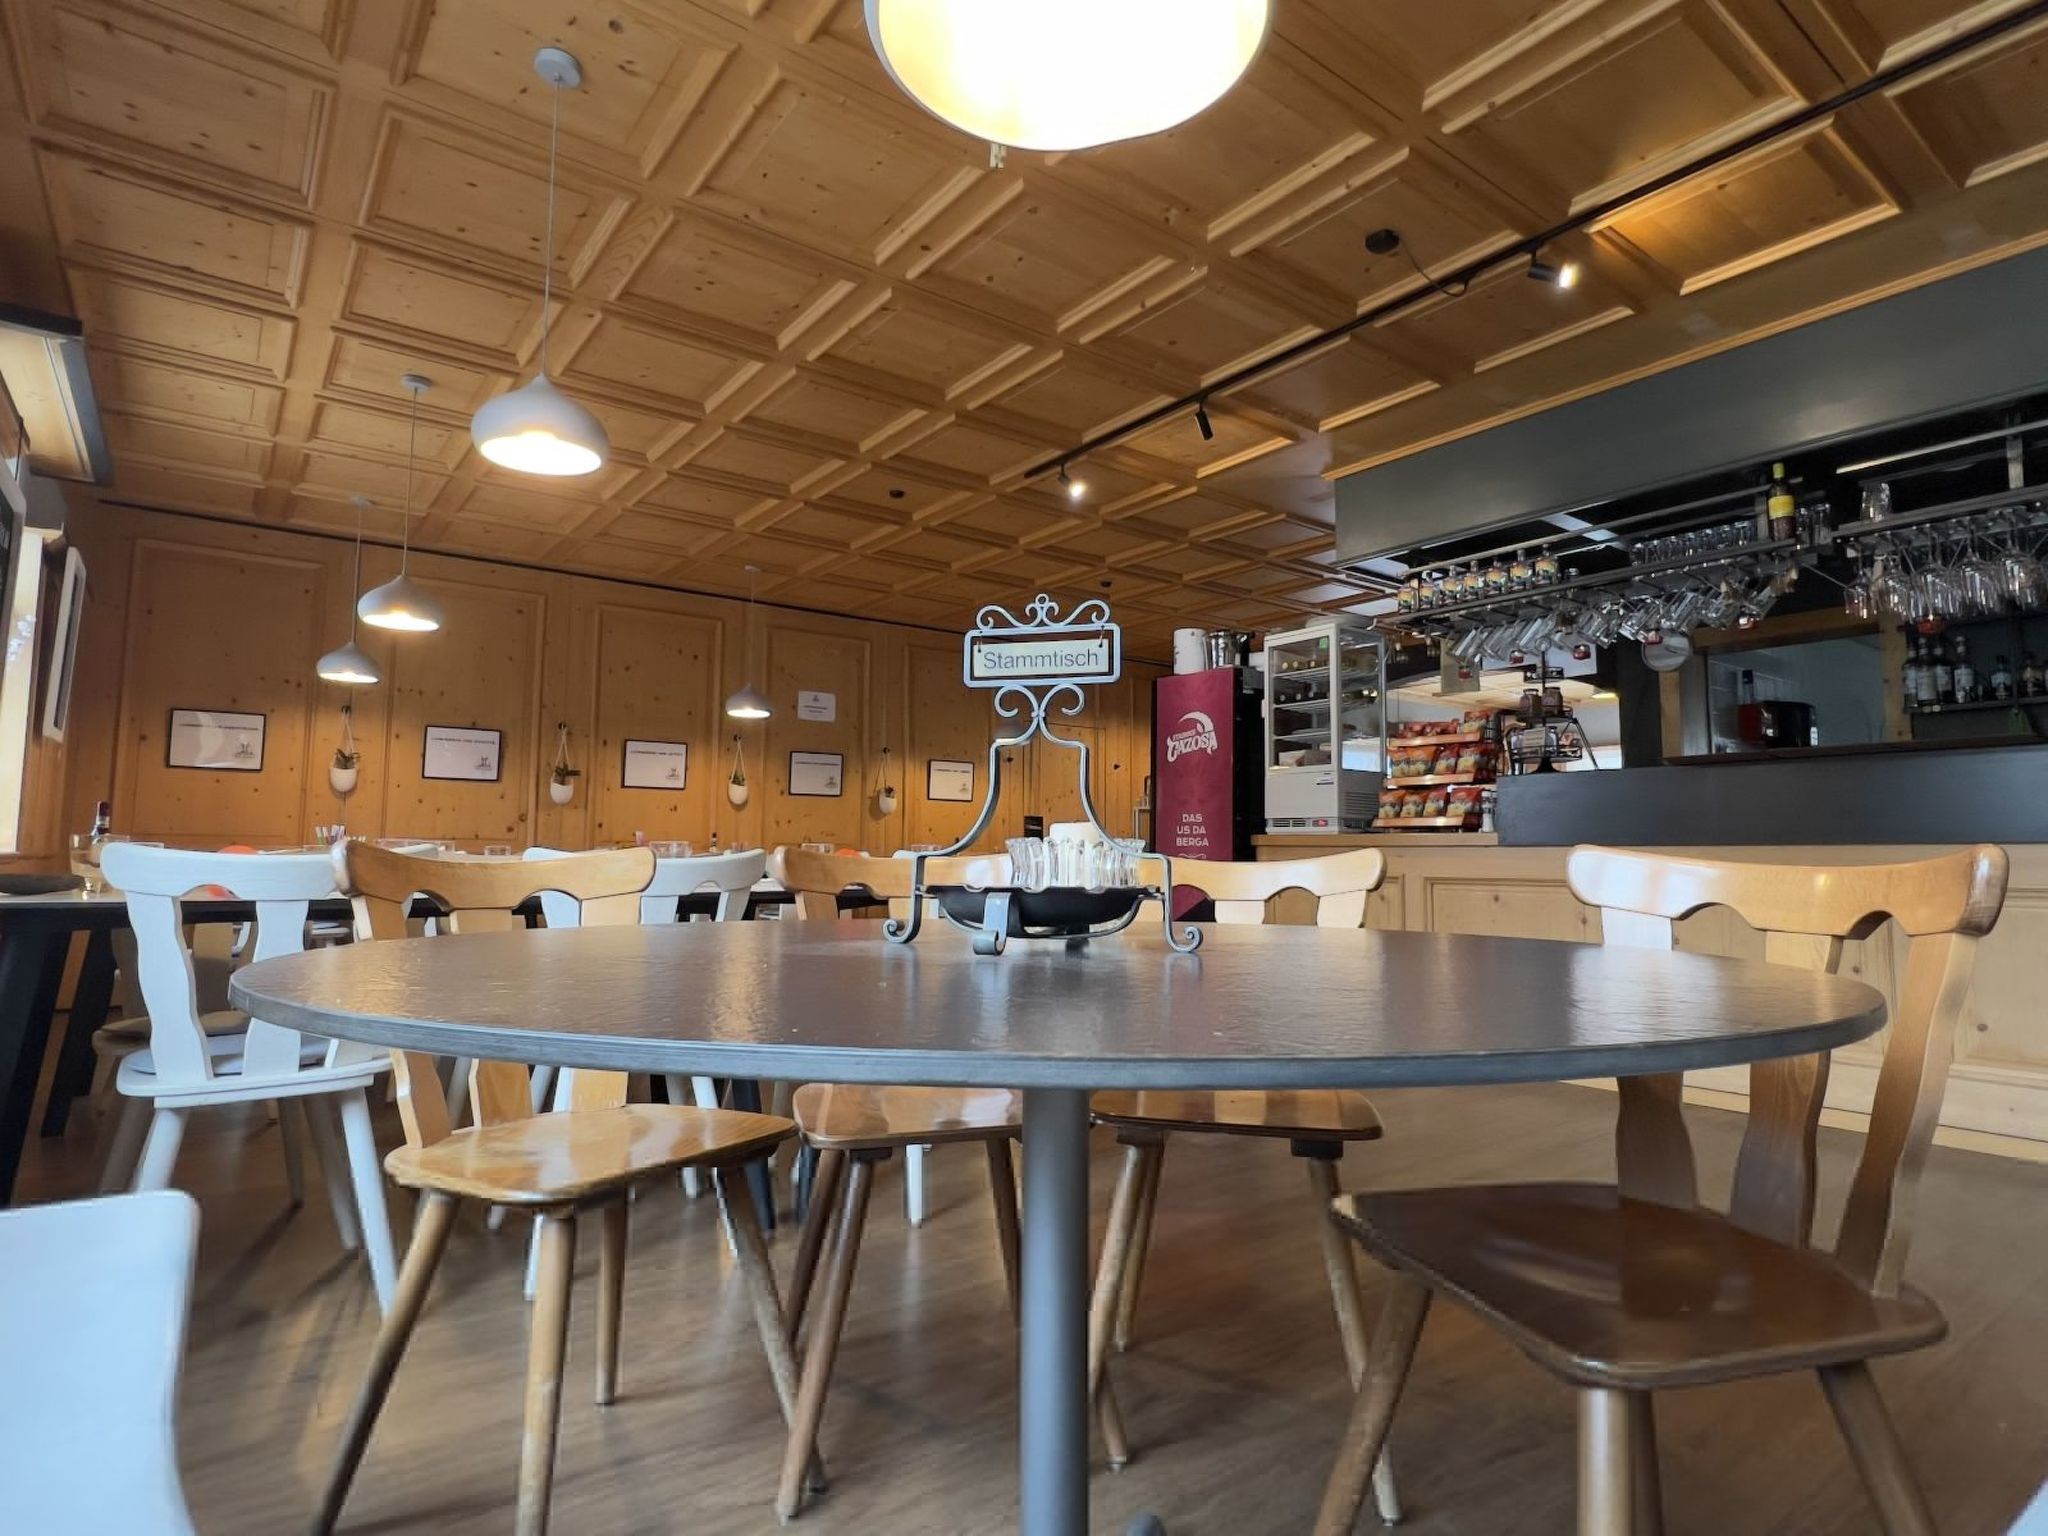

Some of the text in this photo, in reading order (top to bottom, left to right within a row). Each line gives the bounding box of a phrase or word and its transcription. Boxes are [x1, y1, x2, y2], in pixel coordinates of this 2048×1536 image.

[983, 648, 1099, 670] Stammtisch
[1182, 813, 1203, 823] DAS
[1176, 825, 1207, 834] US DA
[1176, 837, 1209, 847] BERGA
